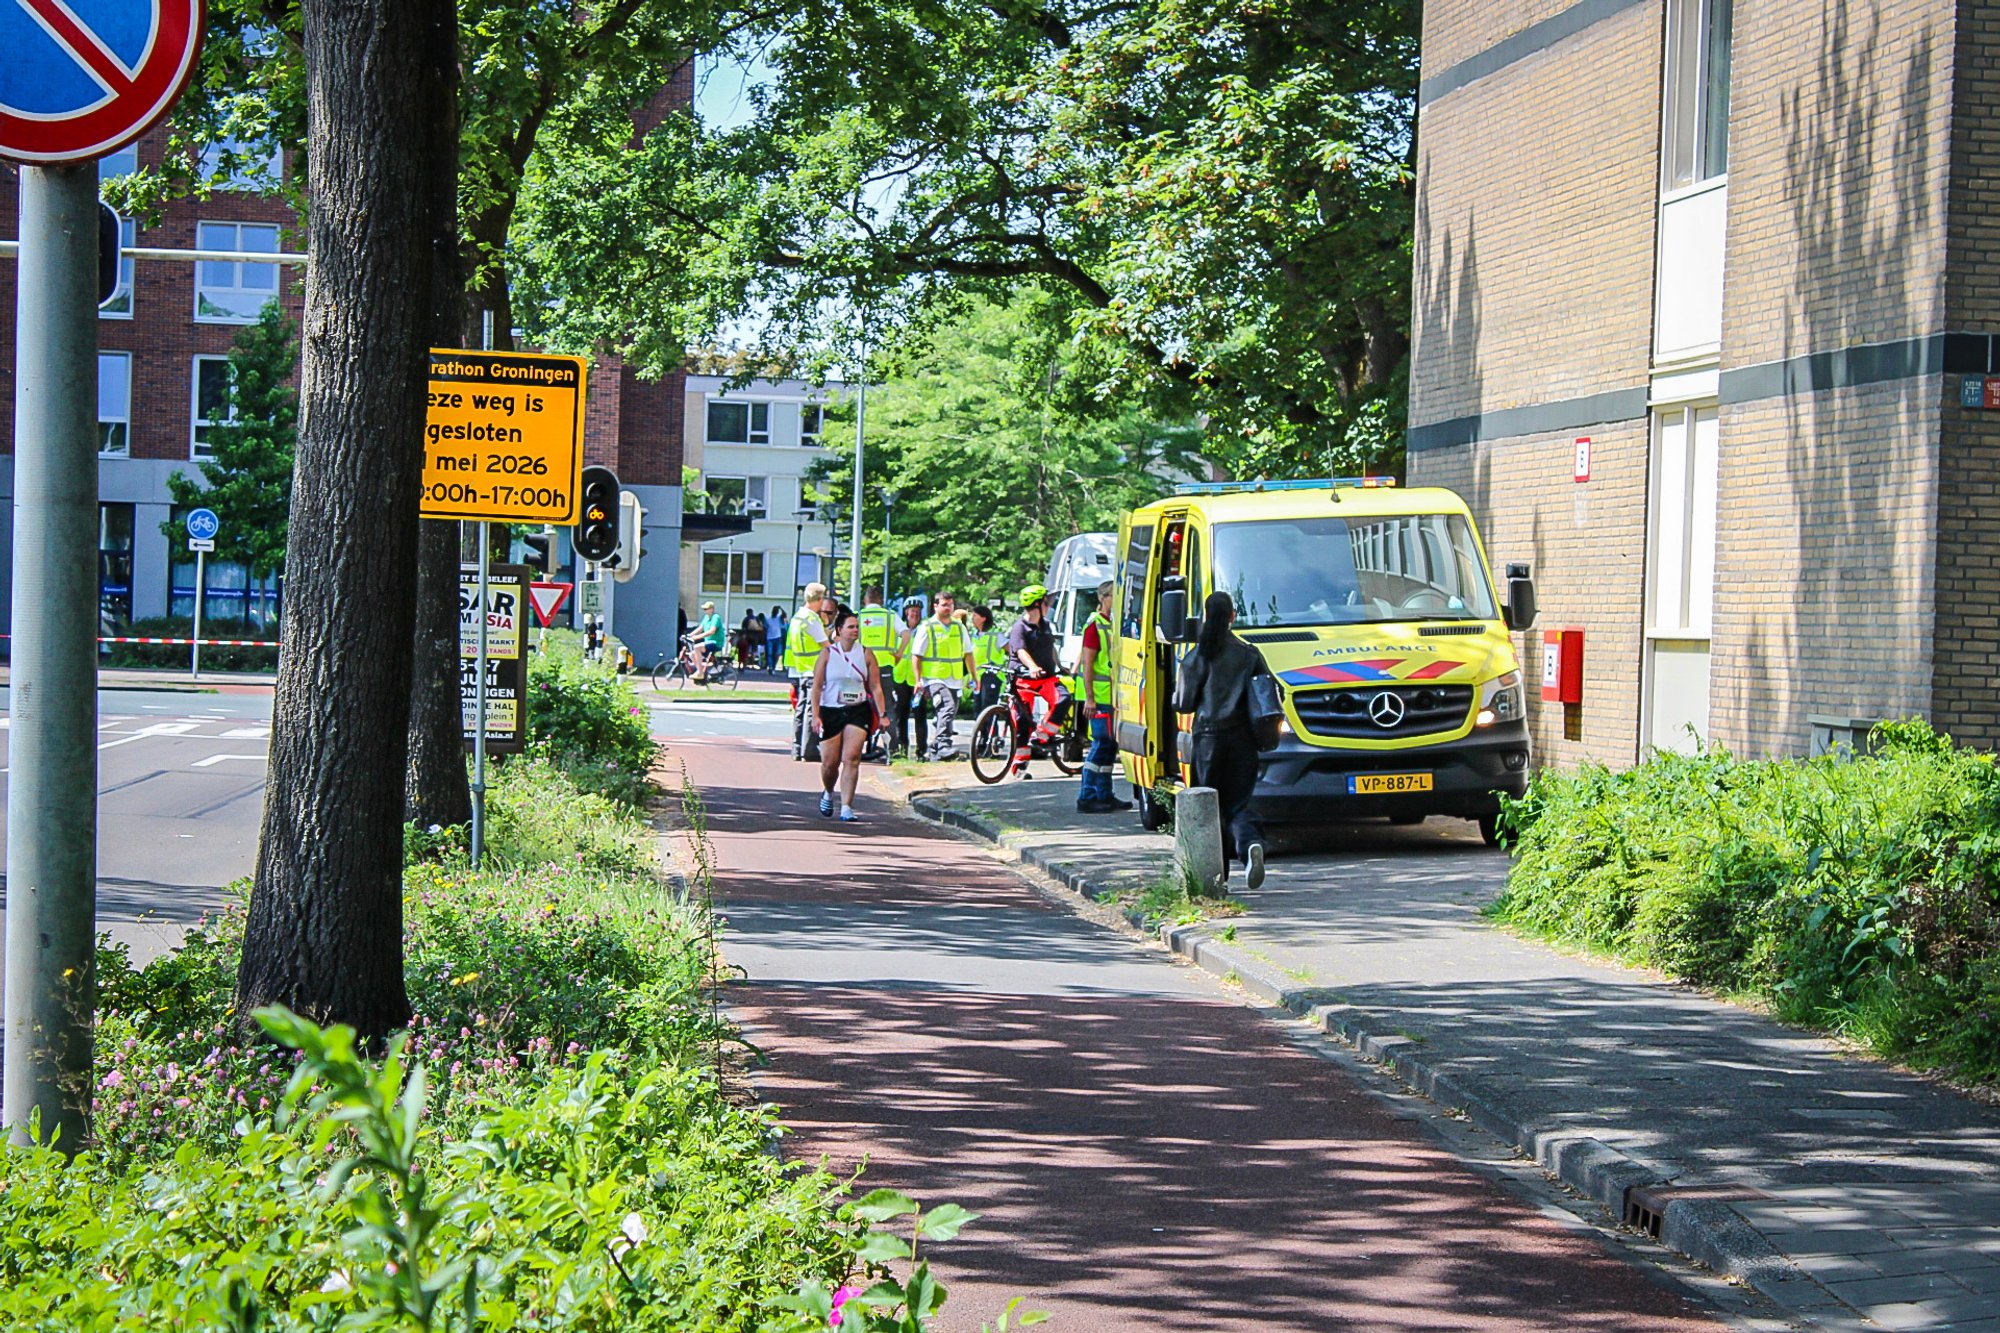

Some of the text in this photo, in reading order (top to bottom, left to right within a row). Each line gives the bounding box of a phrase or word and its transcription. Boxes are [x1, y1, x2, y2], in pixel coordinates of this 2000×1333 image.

[431, 361, 574, 384] rathon Groningen
[427, 392, 544, 416] eze weg is
[425, 421, 523, 444] gesloten
[436, 453, 477, 471] mei
[486, 454, 548, 475] 2026
[1312, 645, 1438, 657] AMBULANCE
[1361, 776, 1427, 791] VP-887-L
